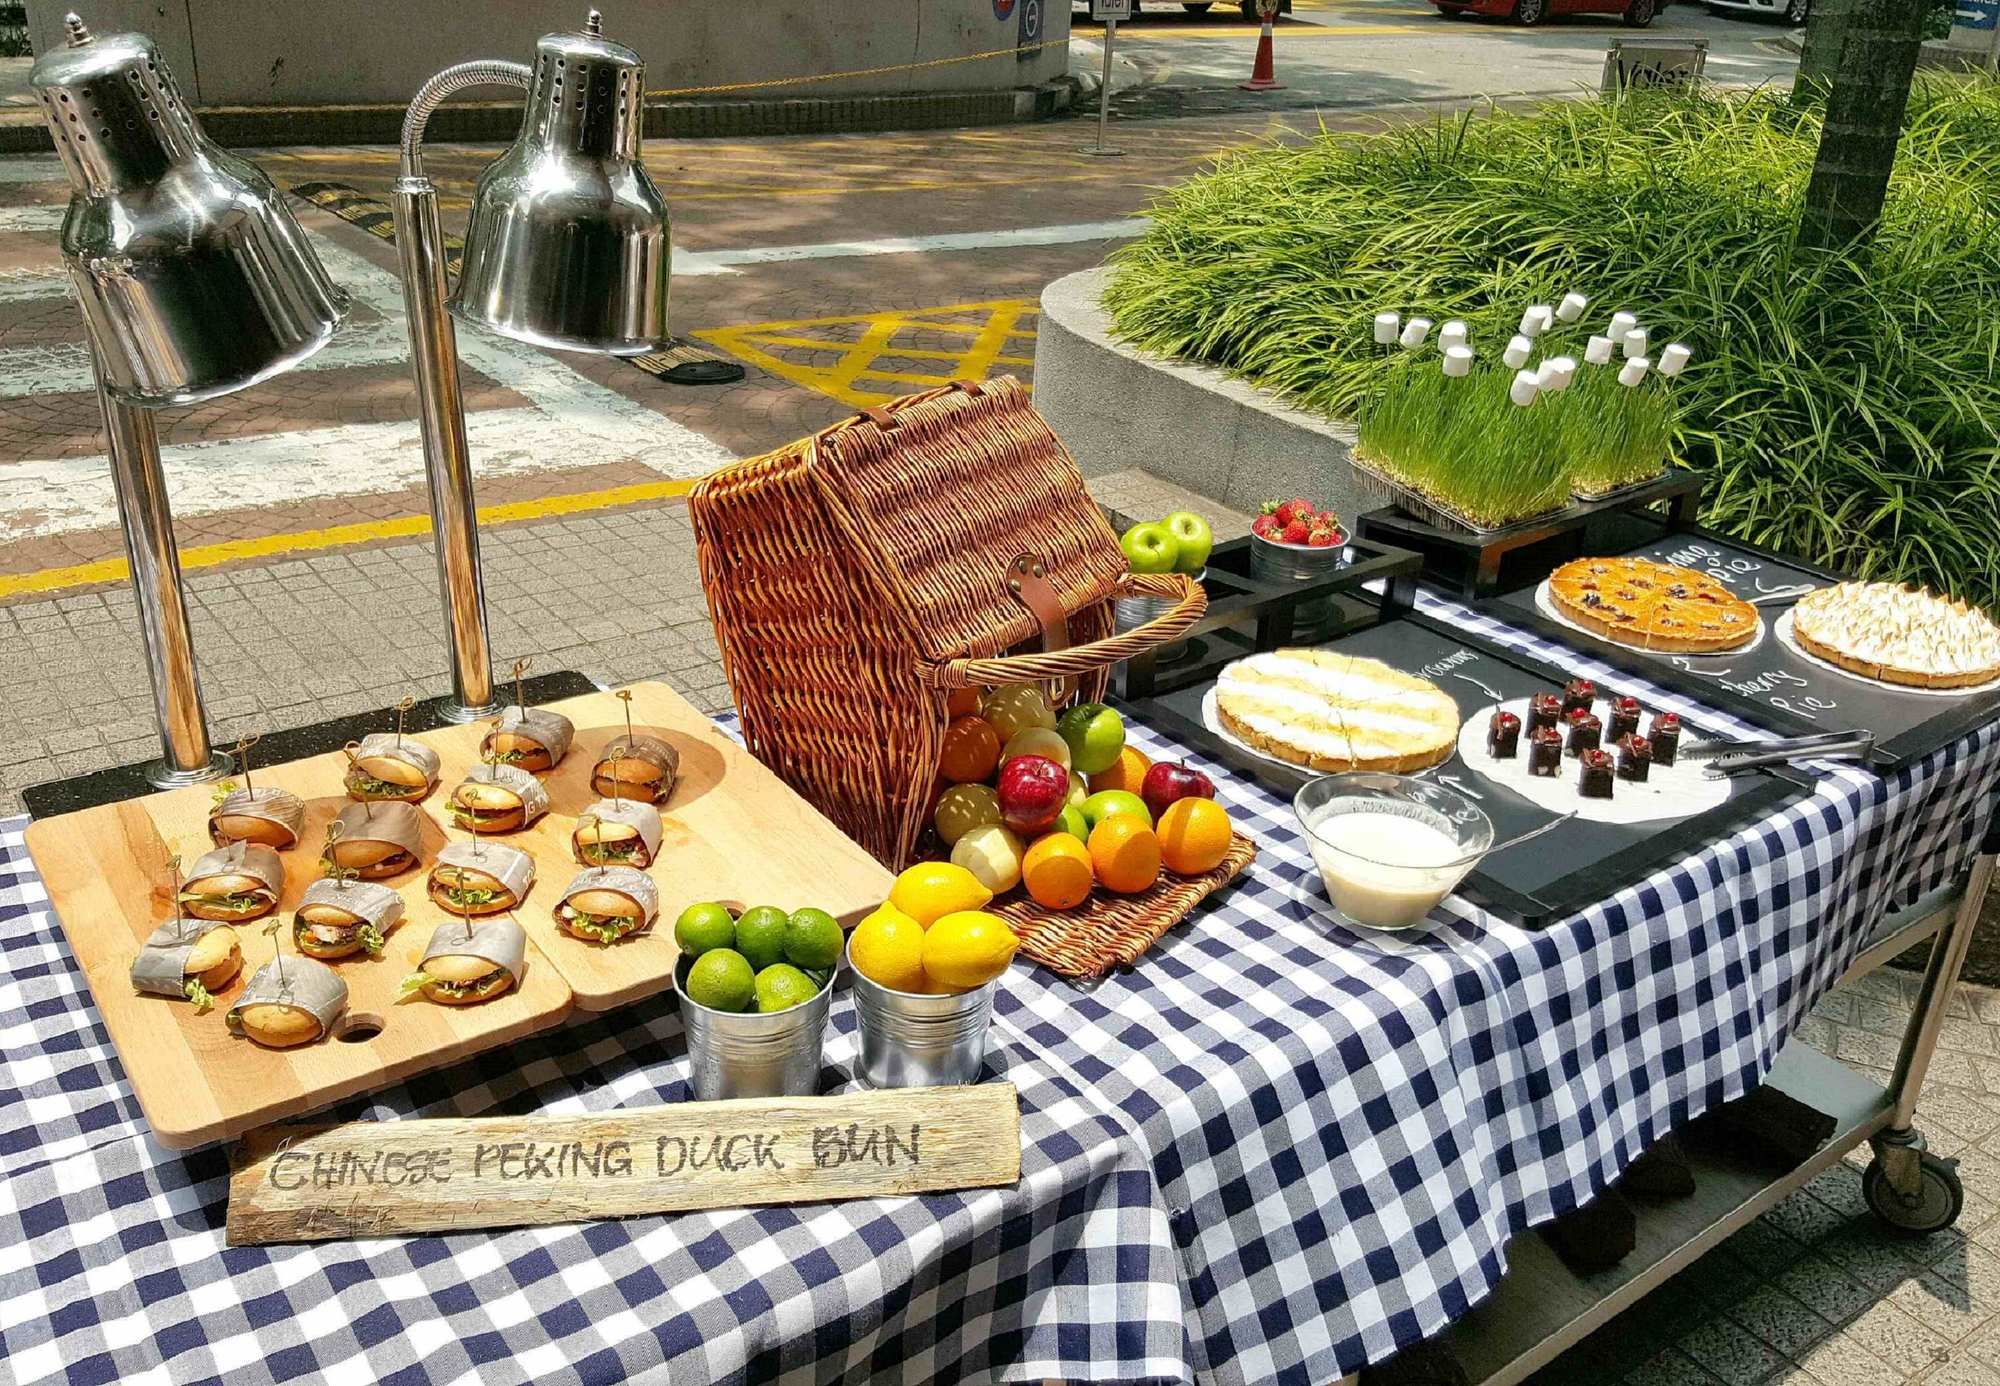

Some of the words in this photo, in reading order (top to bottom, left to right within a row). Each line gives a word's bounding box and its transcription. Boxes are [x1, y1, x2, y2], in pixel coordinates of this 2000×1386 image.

[1769, 694, 1837, 719] Pie
[269, 1147, 453, 1191] CHINESE
[474, 1140, 633, 1180] PEKING
[656, 1133, 785, 1178] DUCK
[812, 1123, 921, 1169] BUN
